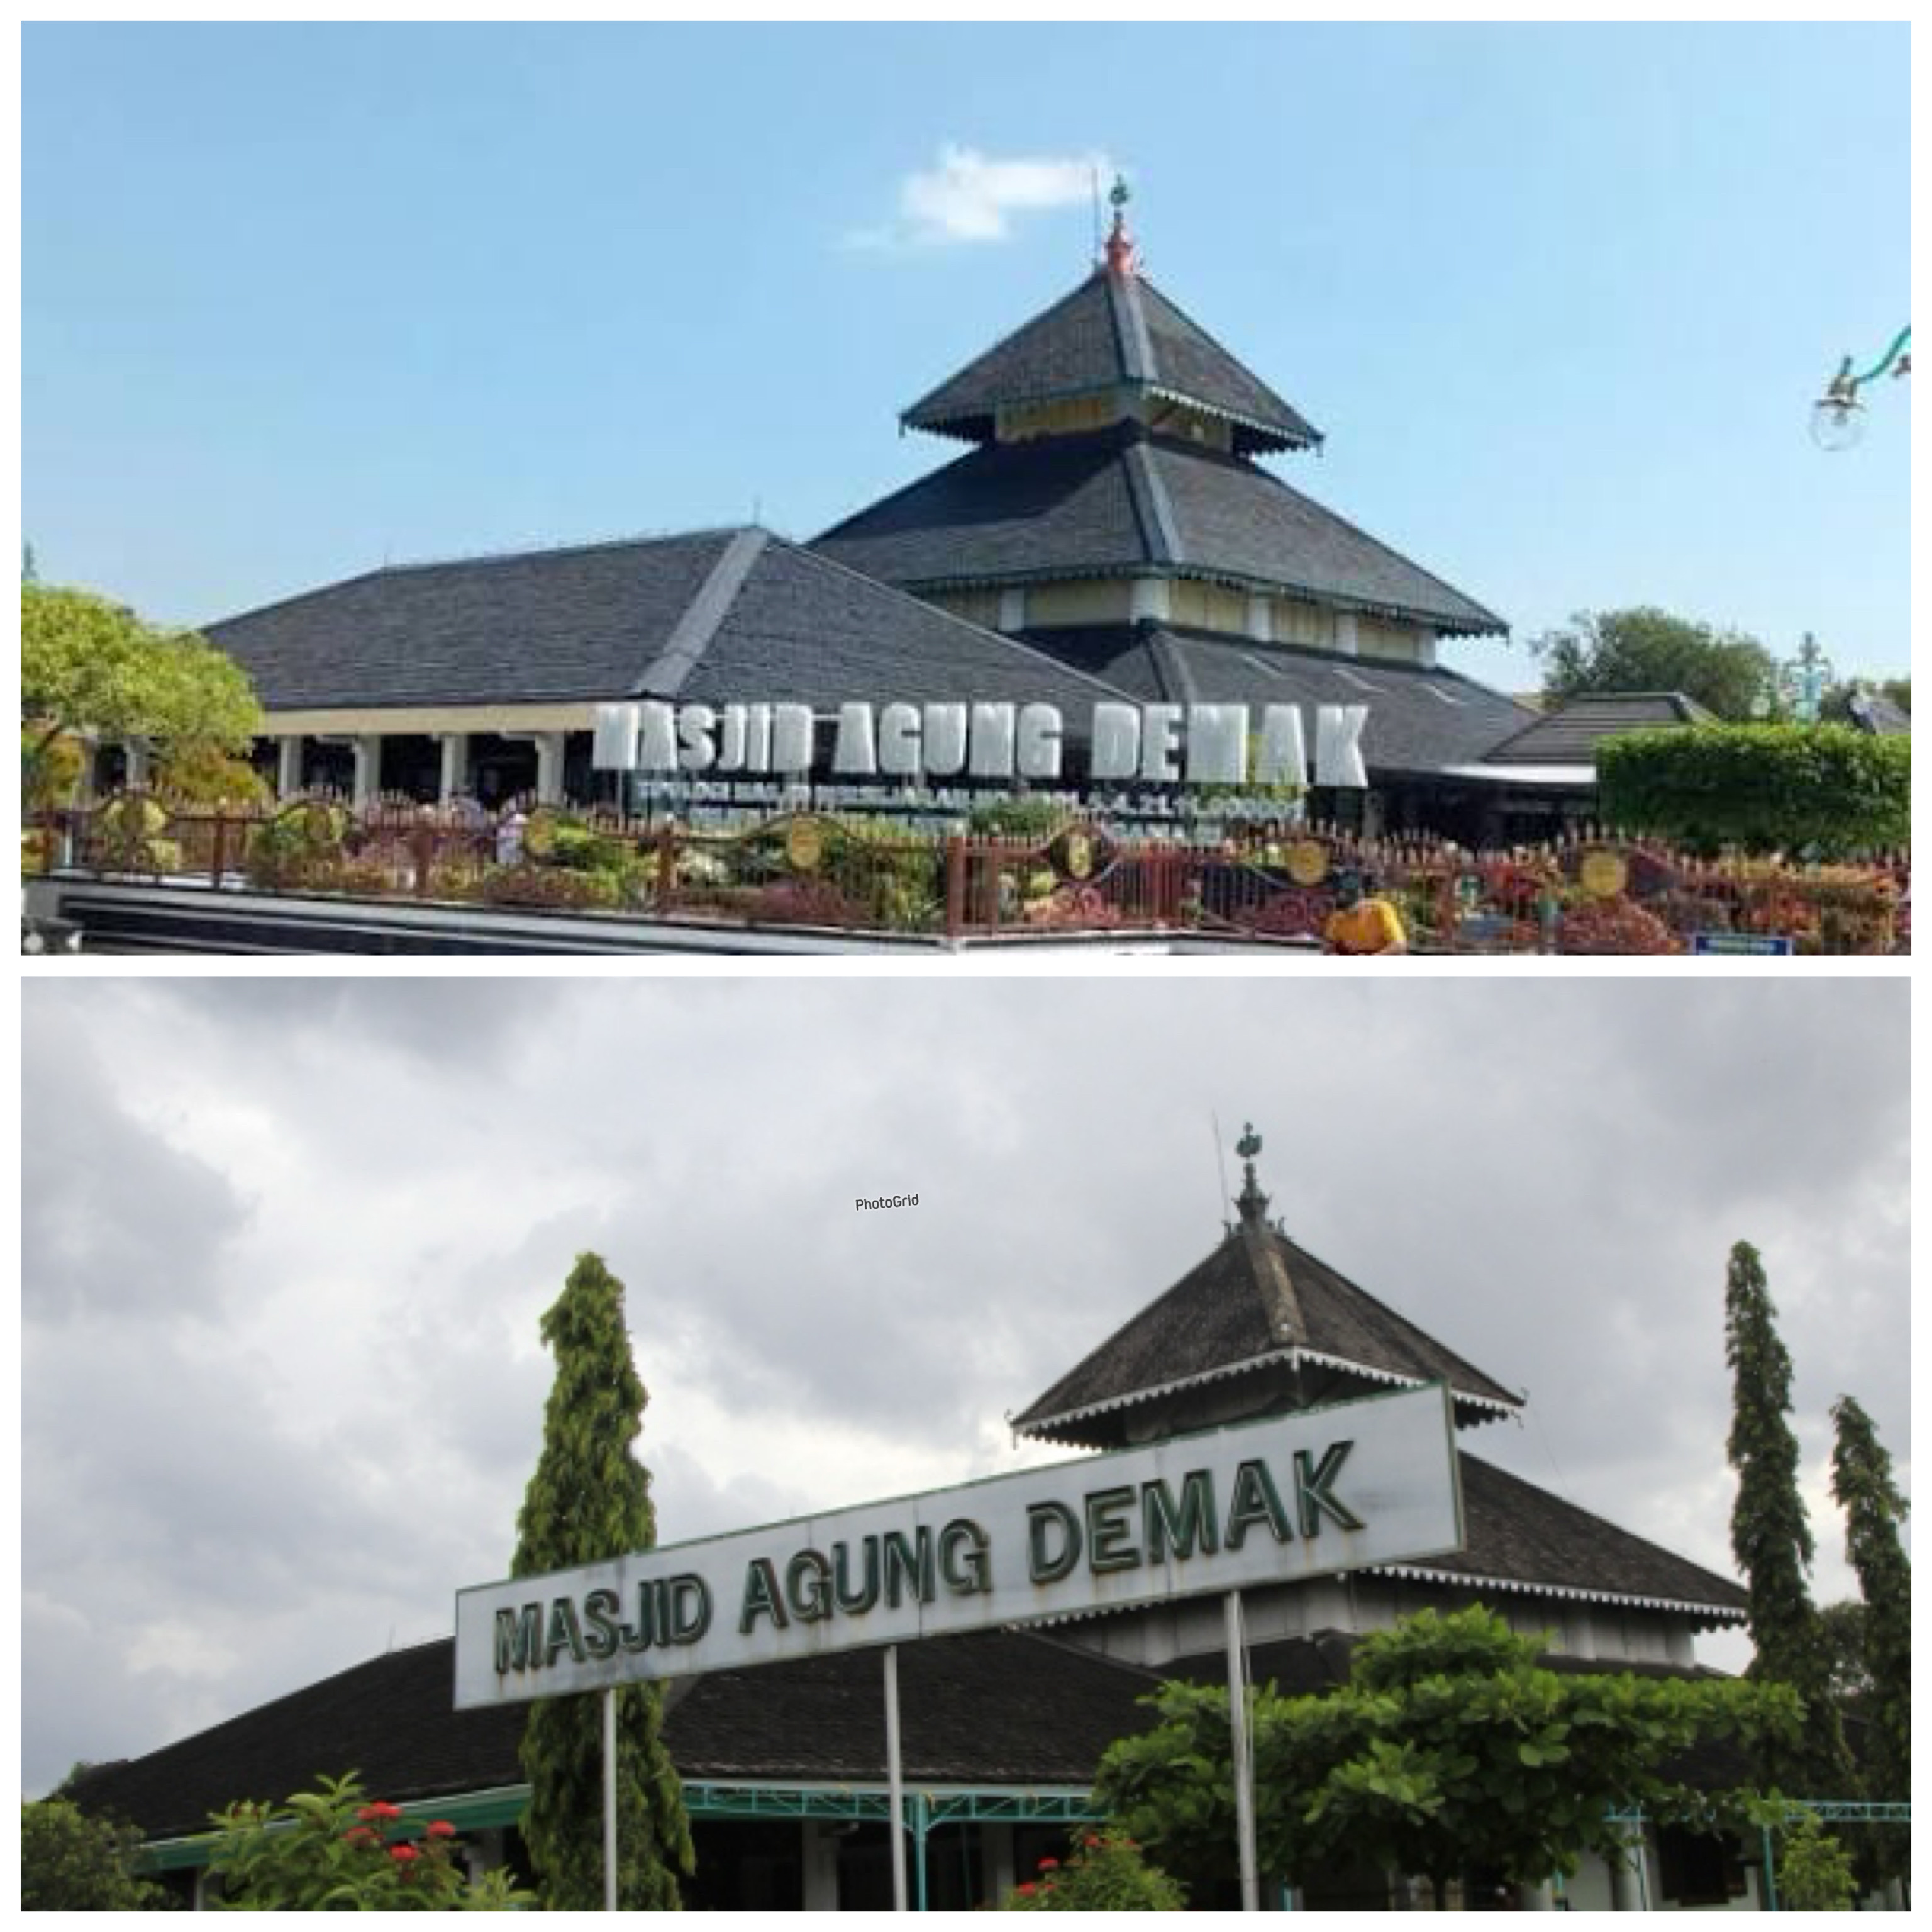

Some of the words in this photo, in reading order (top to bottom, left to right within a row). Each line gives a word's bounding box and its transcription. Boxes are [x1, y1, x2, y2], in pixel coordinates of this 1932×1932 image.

[592, 701, 814, 772] MASJID
[833, 701, 1063, 779] AGUNG
[1090, 701, 1370, 789] DEMAK
[493, 1572, 714, 1674] MASJID
[738, 1518, 994, 1635] AGUNG
[1026, 1439, 1367, 1586] DEMAK
